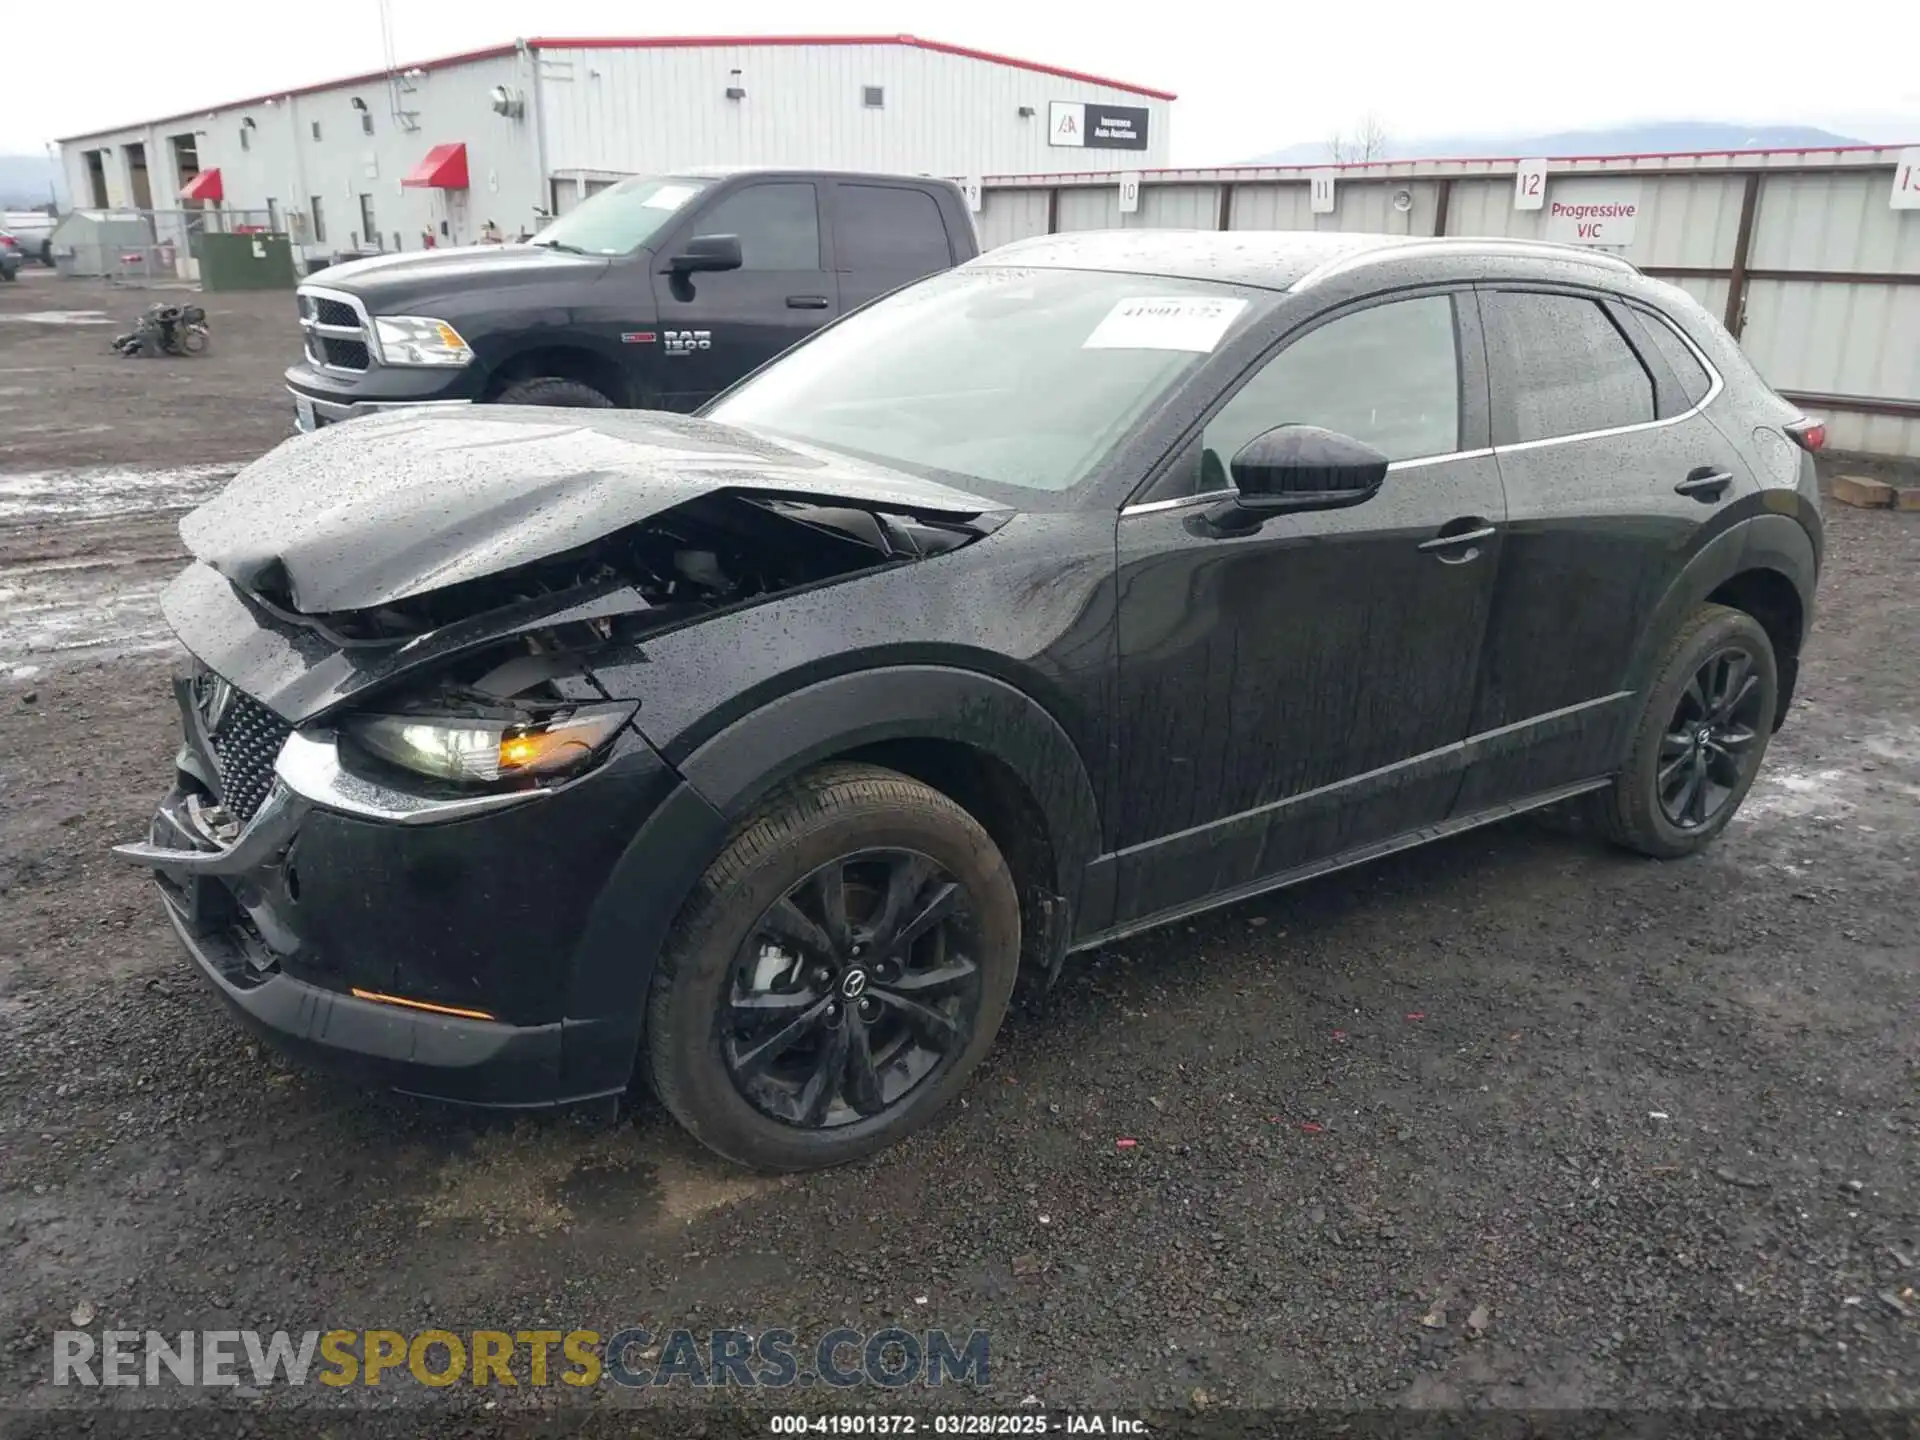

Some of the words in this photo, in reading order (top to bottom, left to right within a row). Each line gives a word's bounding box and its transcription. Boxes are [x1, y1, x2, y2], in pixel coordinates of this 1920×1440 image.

[1094, 127, 1109, 137] Auto
[1123, 183, 1136, 200] 10
[1317, 181, 1328, 199] 11
[1522, 173, 1540, 195] 12
[1551, 202, 1635, 219] Progressive
[1577, 223, 1603, 238] VIC
[664, 330, 711, 340] RAM
[664, 340, 711, 349] 1500
